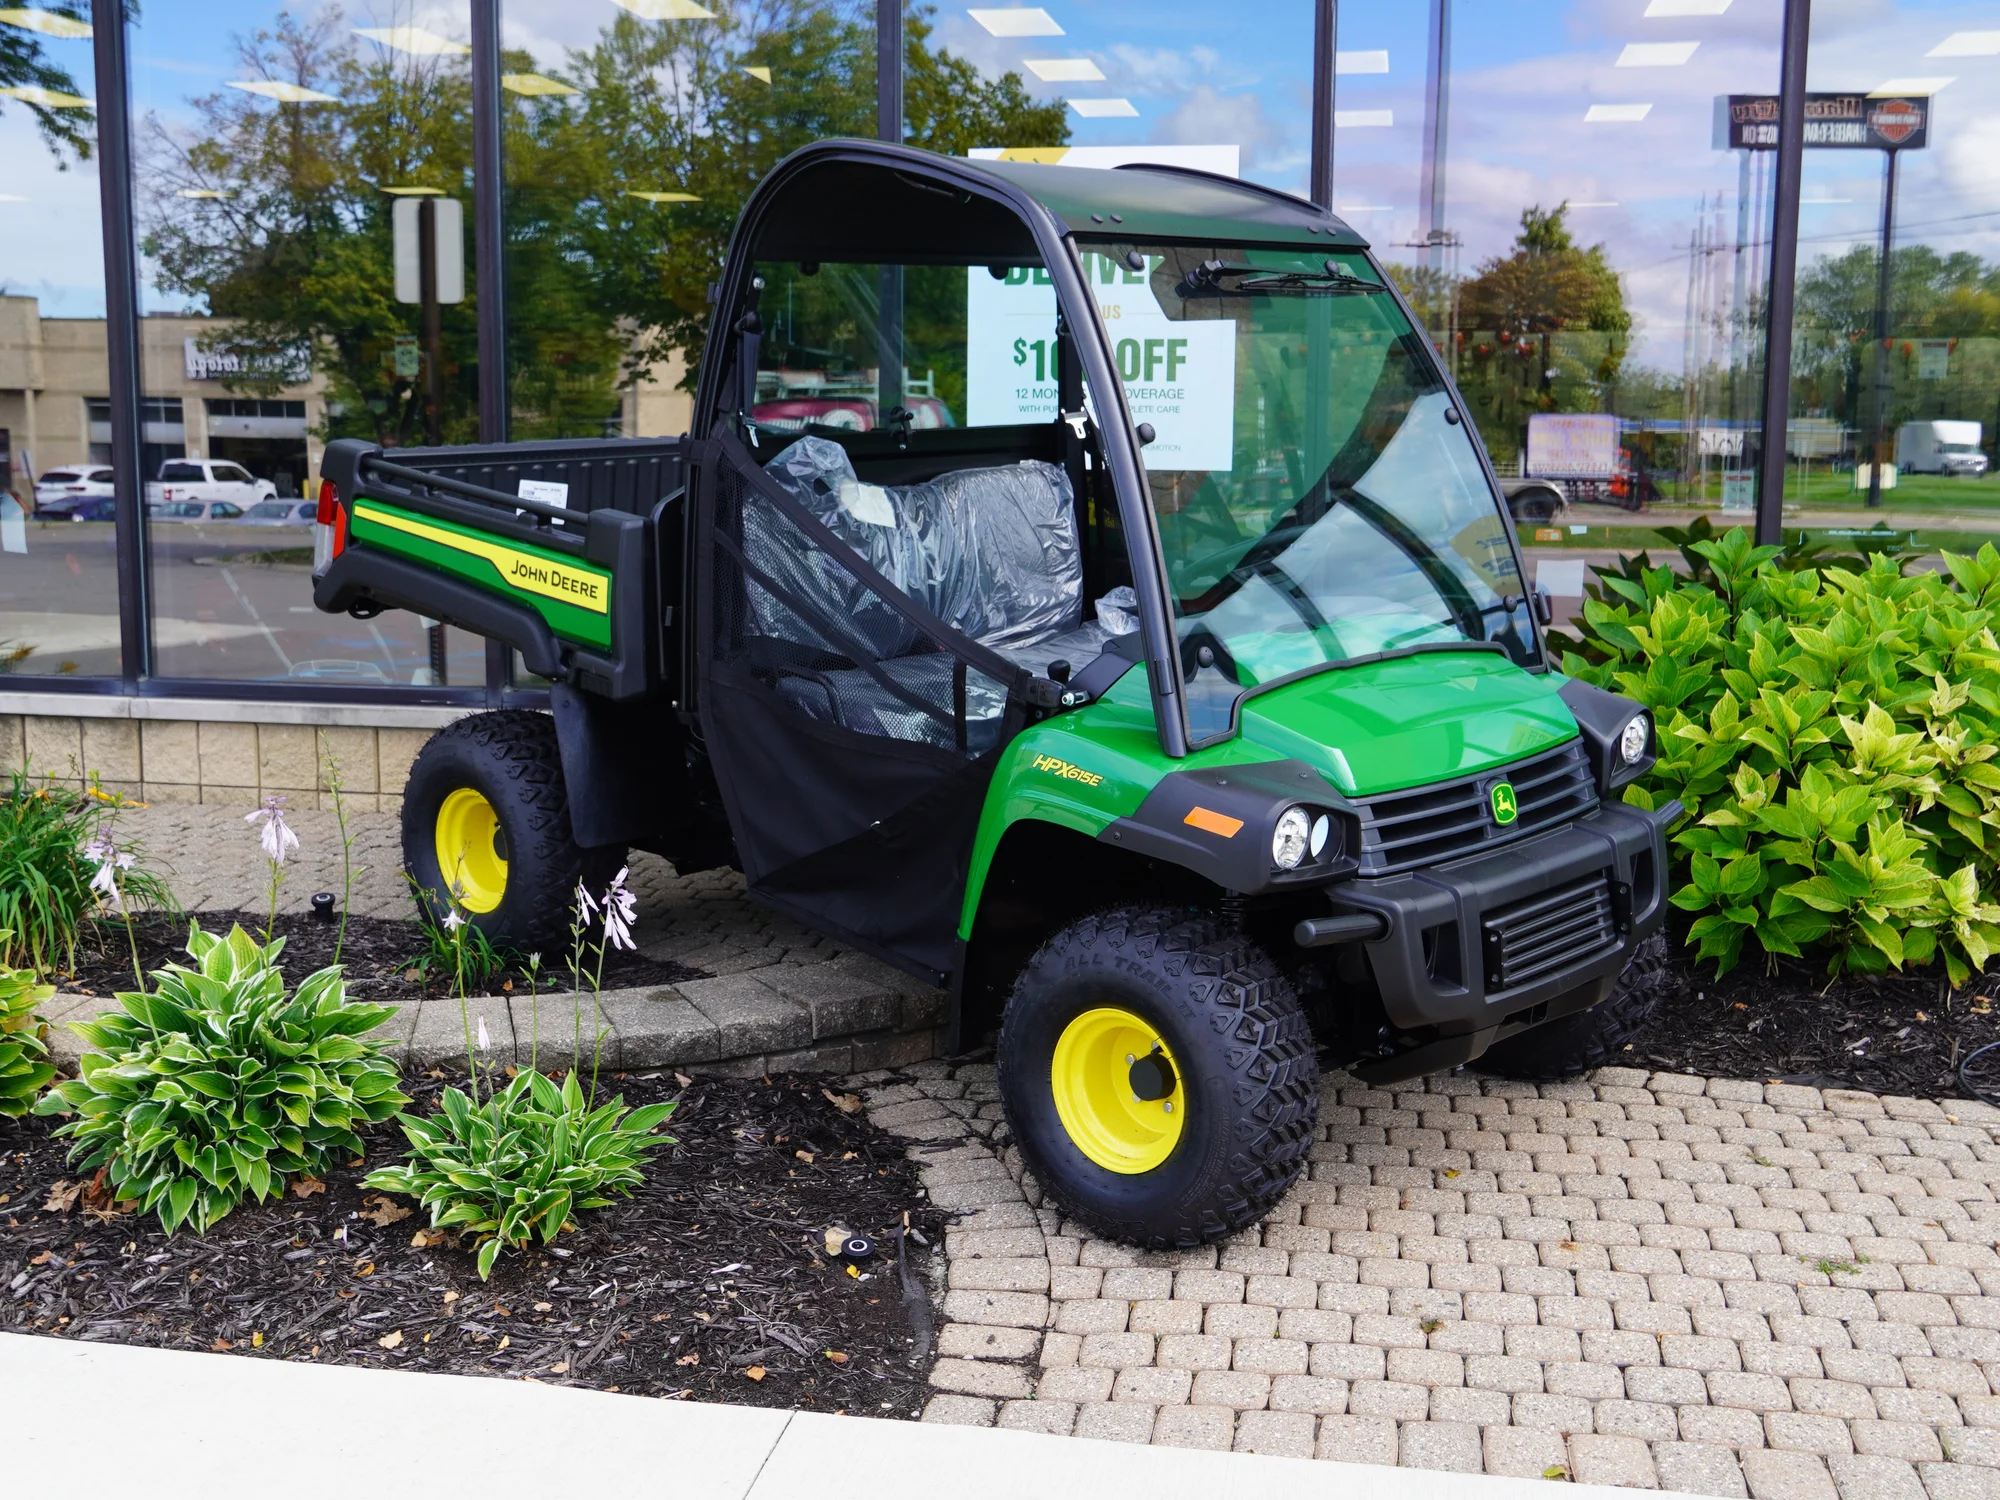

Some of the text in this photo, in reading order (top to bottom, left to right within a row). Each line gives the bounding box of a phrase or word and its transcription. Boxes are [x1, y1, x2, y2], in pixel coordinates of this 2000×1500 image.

[1102, 304, 1121, 319] US
[1116, 338, 1187, 382] OFF
[1016, 388, 1028, 399] 12
[1125, 388, 1184, 399] OVERAGE
[1018, 404, 1040, 413] WITH
[1130, 405, 1154, 413] PLETE
[1157, 405, 1180, 413] CARE
[511, 560, 598, 599] JOHN DEERE
[1031, 754, 1103, 787] HPX615E
[1064, 953, 1104, 972] ALL
[1114, 955, 1173, 1001] TRAIL
